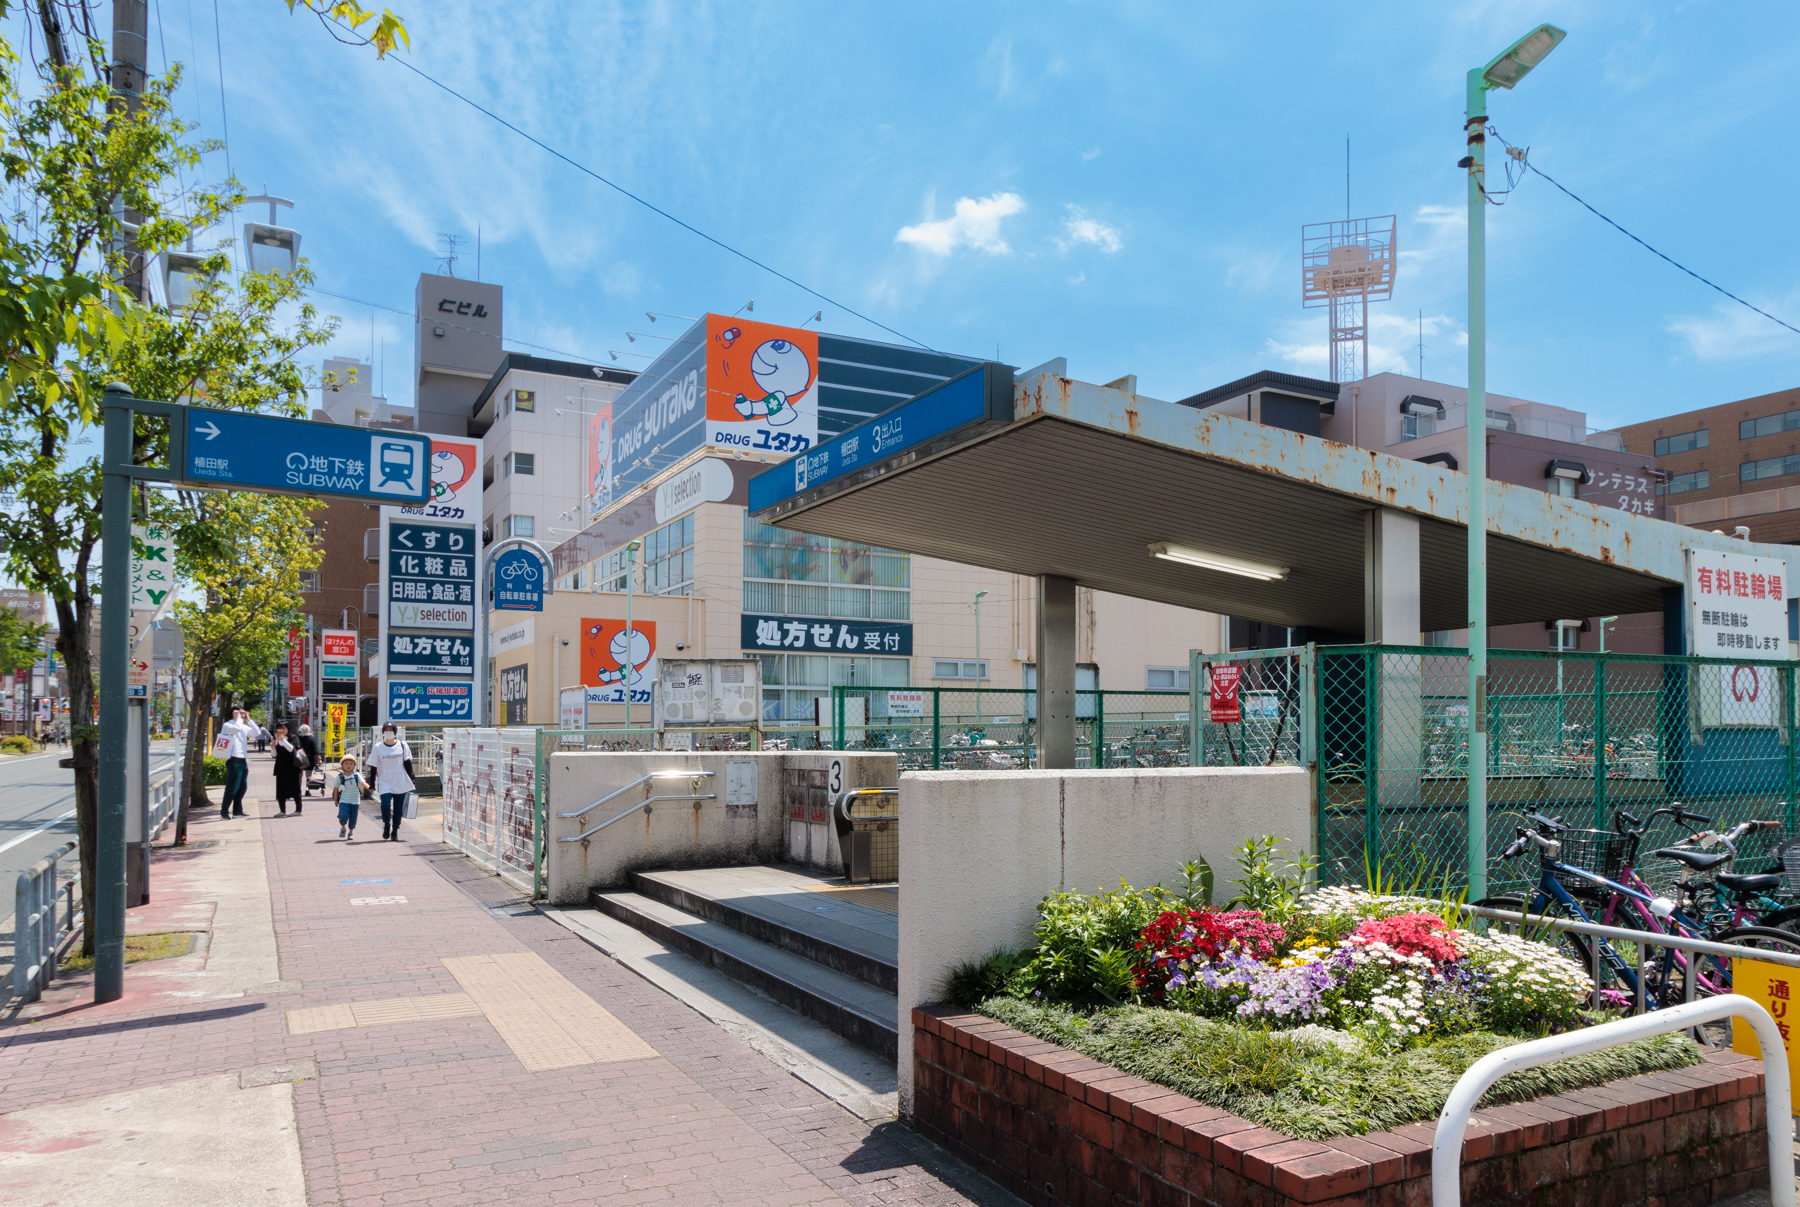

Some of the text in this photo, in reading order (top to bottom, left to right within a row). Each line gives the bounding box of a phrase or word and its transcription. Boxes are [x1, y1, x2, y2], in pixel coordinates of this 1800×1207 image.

[438, 298, 488, 318] 仁ビル
[617, 422, 643, 463] DRUG
[715, 429, 811, 453] DRUG ユタカ
[872, 416, 902, 454] 3 出入口
[881, 434, 904, 450] Entrance
[194, 456, 229, 470] 植田駅
[309, 454, 365, 476] 地下鉄
[812, 451, 830, 468] 地下鉄
[194, 467, 235, 478] Ueda Sta.
[286, 471, 364, 491] SUBWAY
[807, 465, 829, 482] SUBWAY
[1587, 468, 1648, 494] サンテラス
[674, 470, 702, 505] selection
[400, 504, 465, 519] DRUG ユタカ
[1617, 495, 1655, 515] タカギ
[397, 529, 464, 551] くすり
[131, 541, 144, 604] ネジメント
[399, 555, 468, 577] 化粧品
[1697, 566, 1783, 602] 有料駐輪場
[420, 607, 468, 622] selection
[1701, 609, 1749, 628] 無断駐輪は
[325, 638, 355, 646] ほけんの
[393, 636, 470, 656] 処方せん
[1716, 632, 1780, 651] 即時移動します
[292, 636, 301, 683] ほんの窓口
[441, 656, 470, 666] 受付
[501, 668, 528, 702] 処方せん
[392, 698, 470, 715] クリーニング
[587, 694, 610, 702] DRUG
[830, 760, 841, 794] 3
[1767, 978, 1791, 1052] 通り抜
